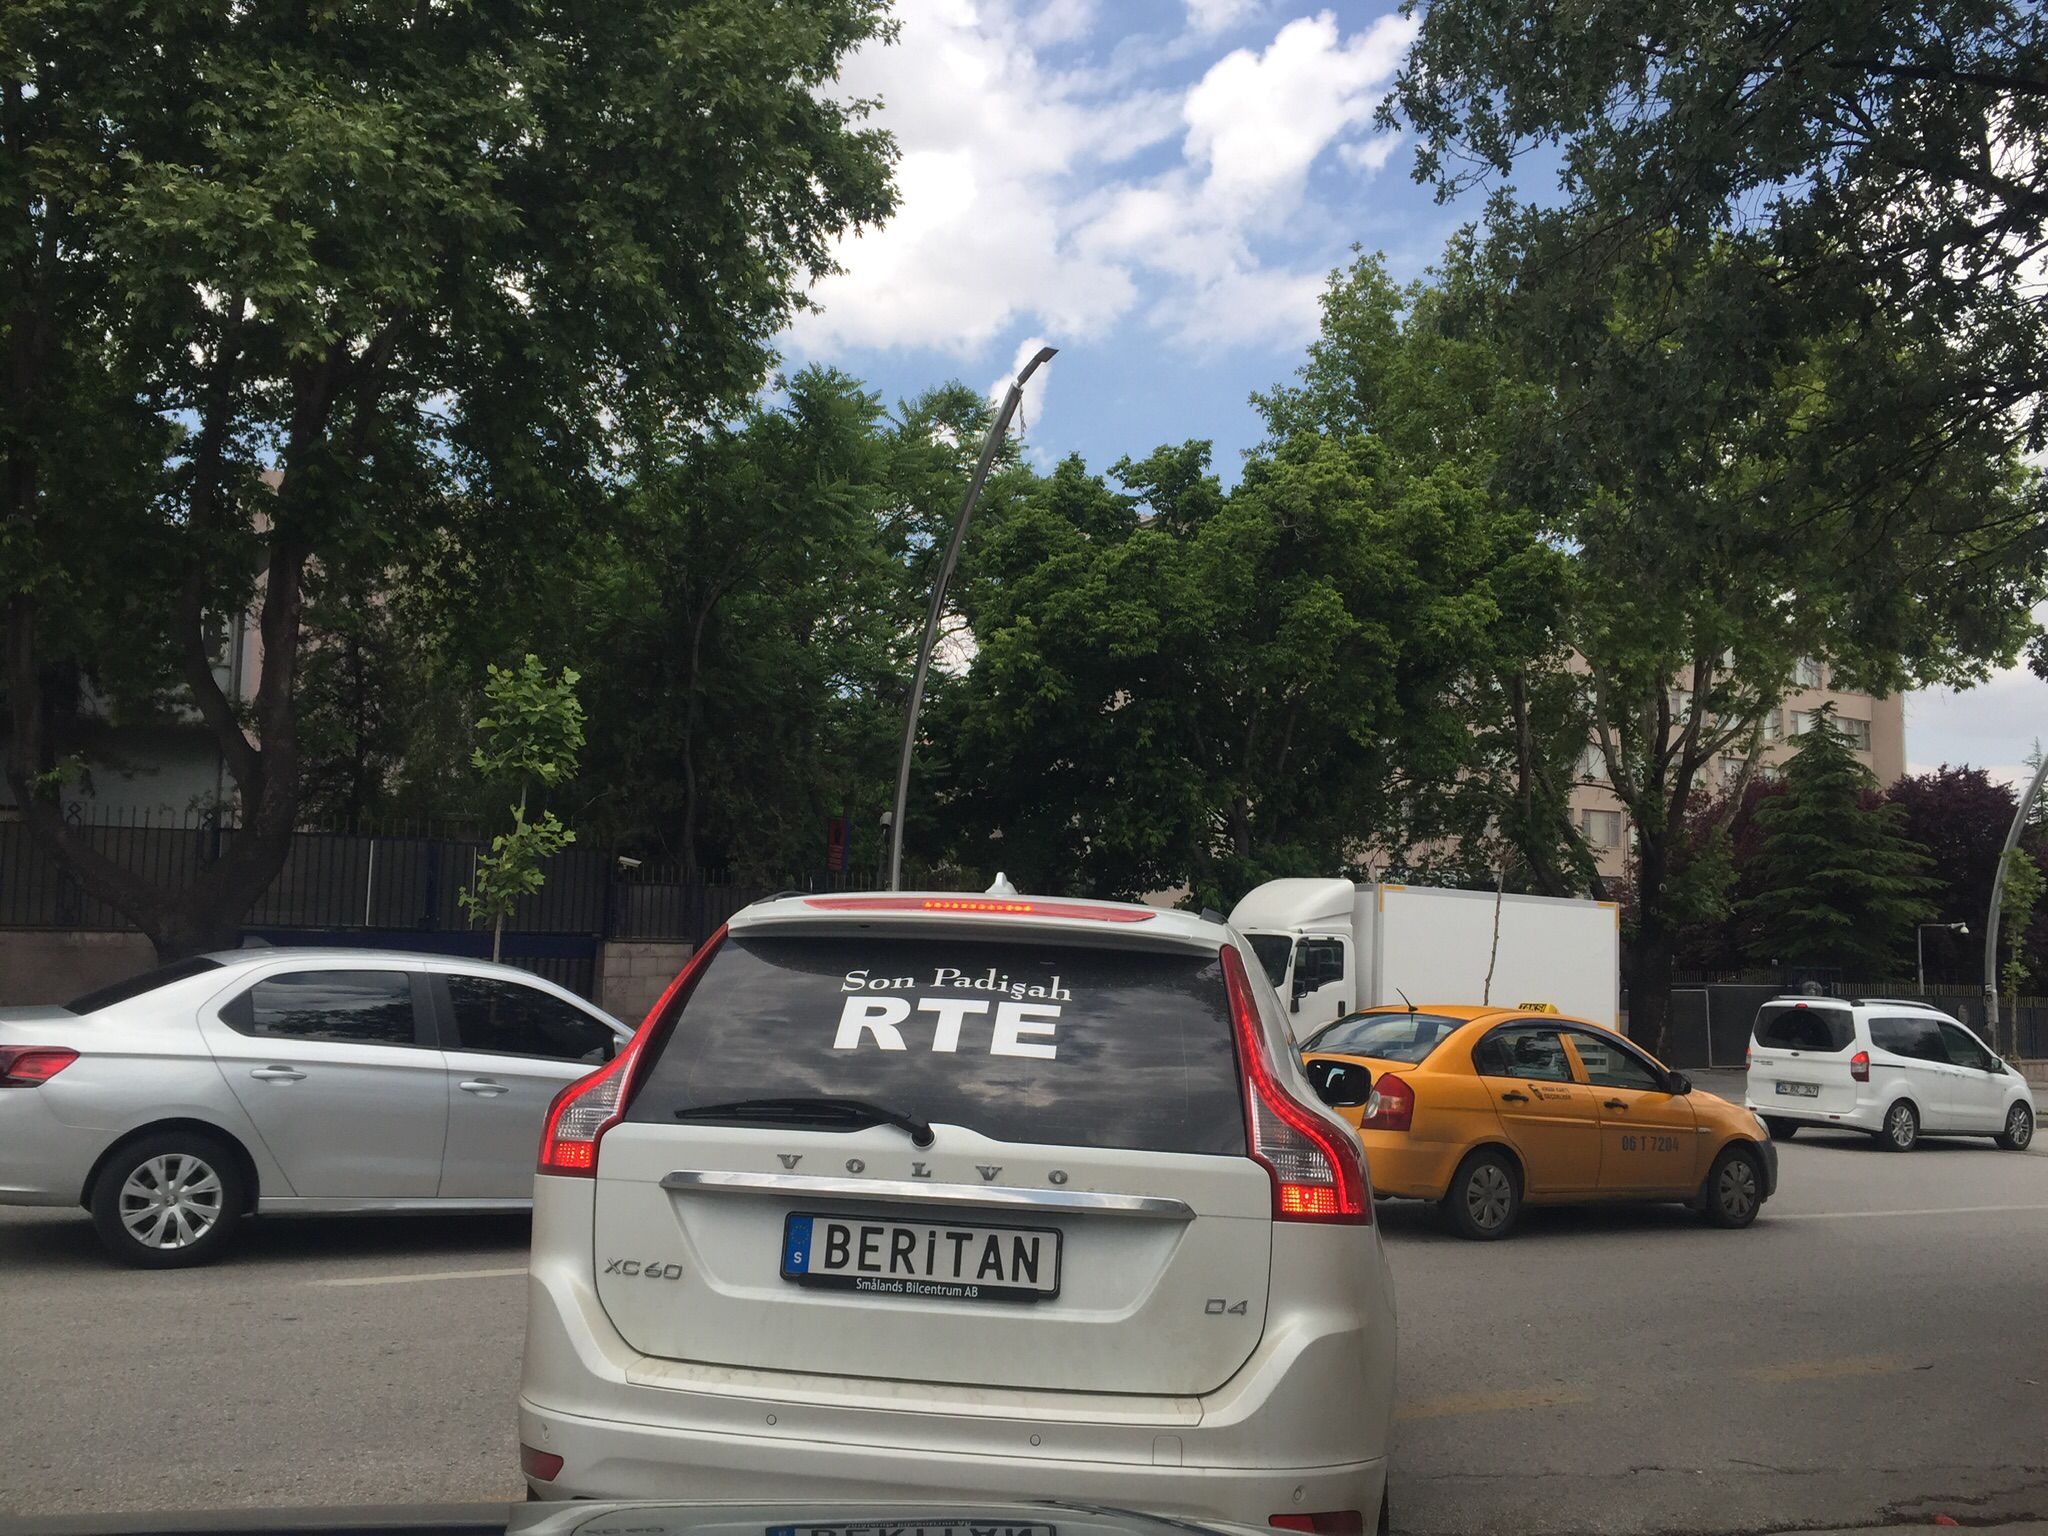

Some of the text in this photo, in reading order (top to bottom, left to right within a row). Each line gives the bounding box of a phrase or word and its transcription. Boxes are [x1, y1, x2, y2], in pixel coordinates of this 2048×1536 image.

[840, 967, 1072, 1001] Son Padişah
[833, 996, 1061, 1060] RTE
[777, 1154, 1068, 1185] VOLVO
[793, 1251, 803, 1264] S
[856, 1278, 979, 1298] Smålands Bilcentrum AB
[1204, 1298, 1248, 1316] D4
